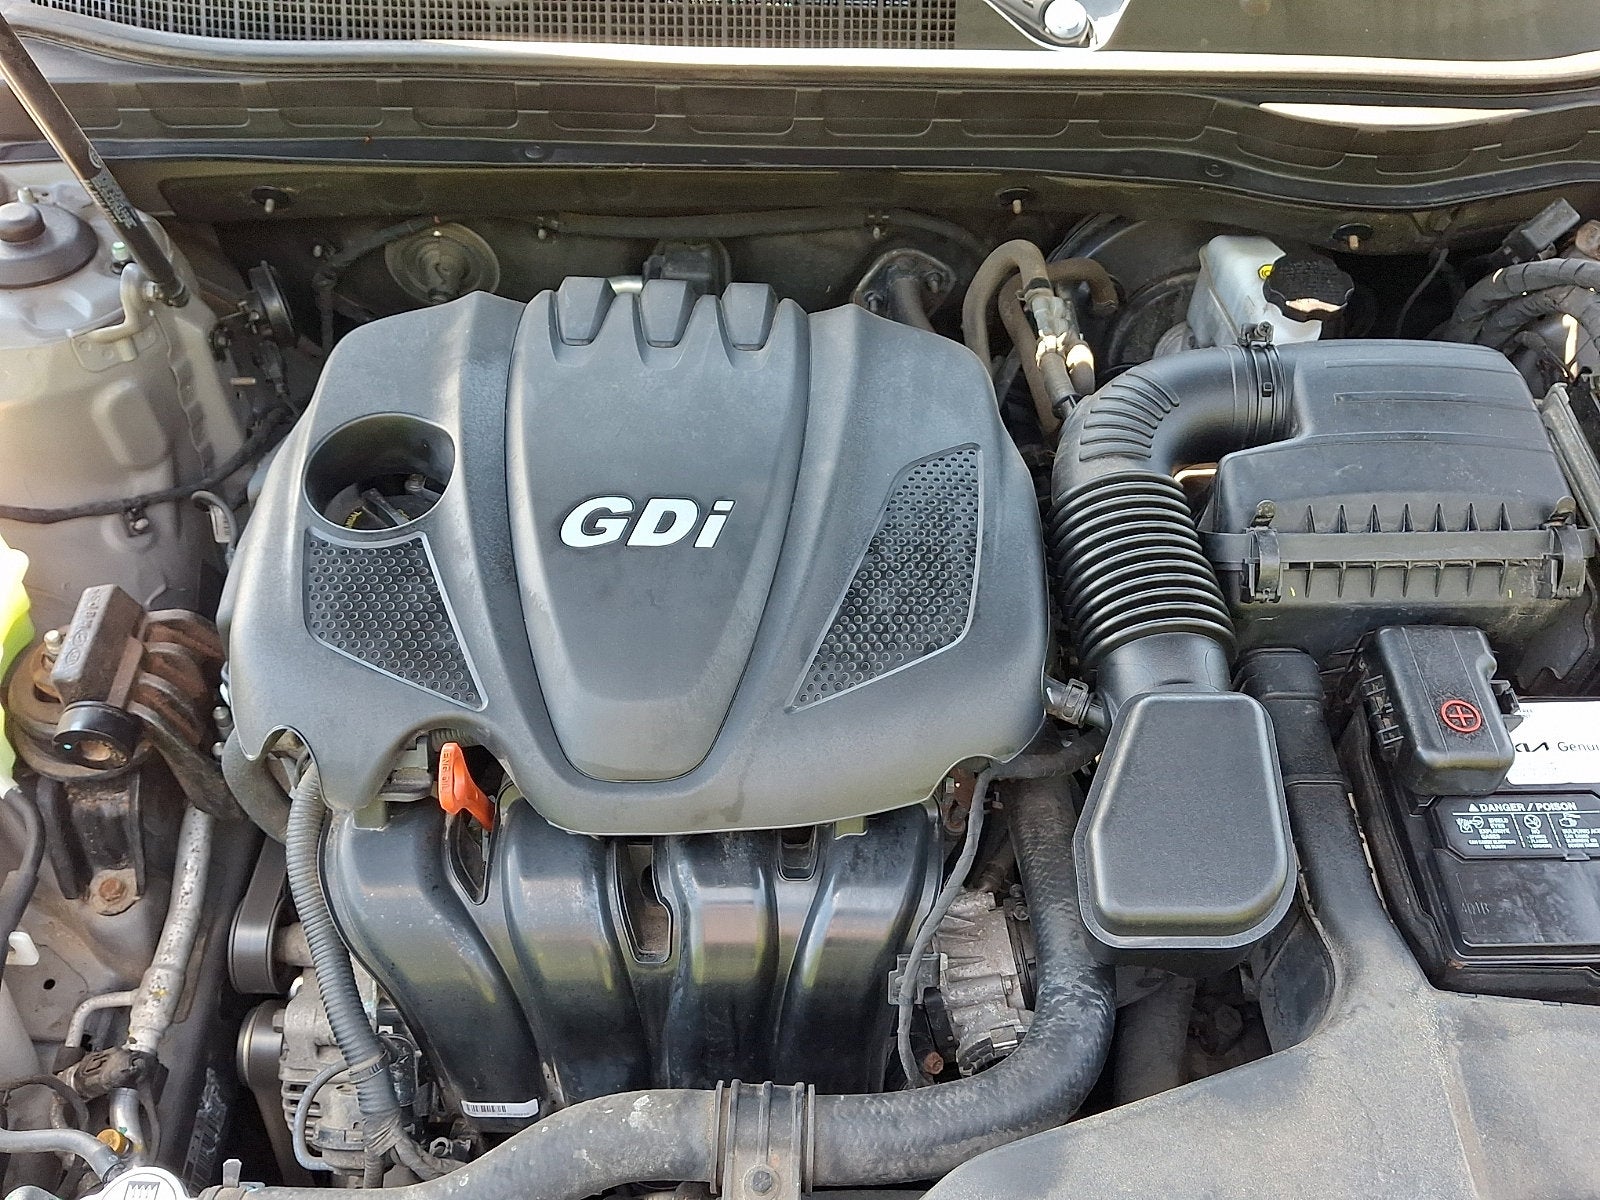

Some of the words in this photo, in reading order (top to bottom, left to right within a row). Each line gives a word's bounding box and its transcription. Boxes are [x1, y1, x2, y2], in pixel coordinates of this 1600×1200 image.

[559, 495, 736, 549] GDi
[442, 751, 451, 772] ENG
[1479, 803, 1526, 812] DANGER
[1535, 802, 1577, 811] POISON
